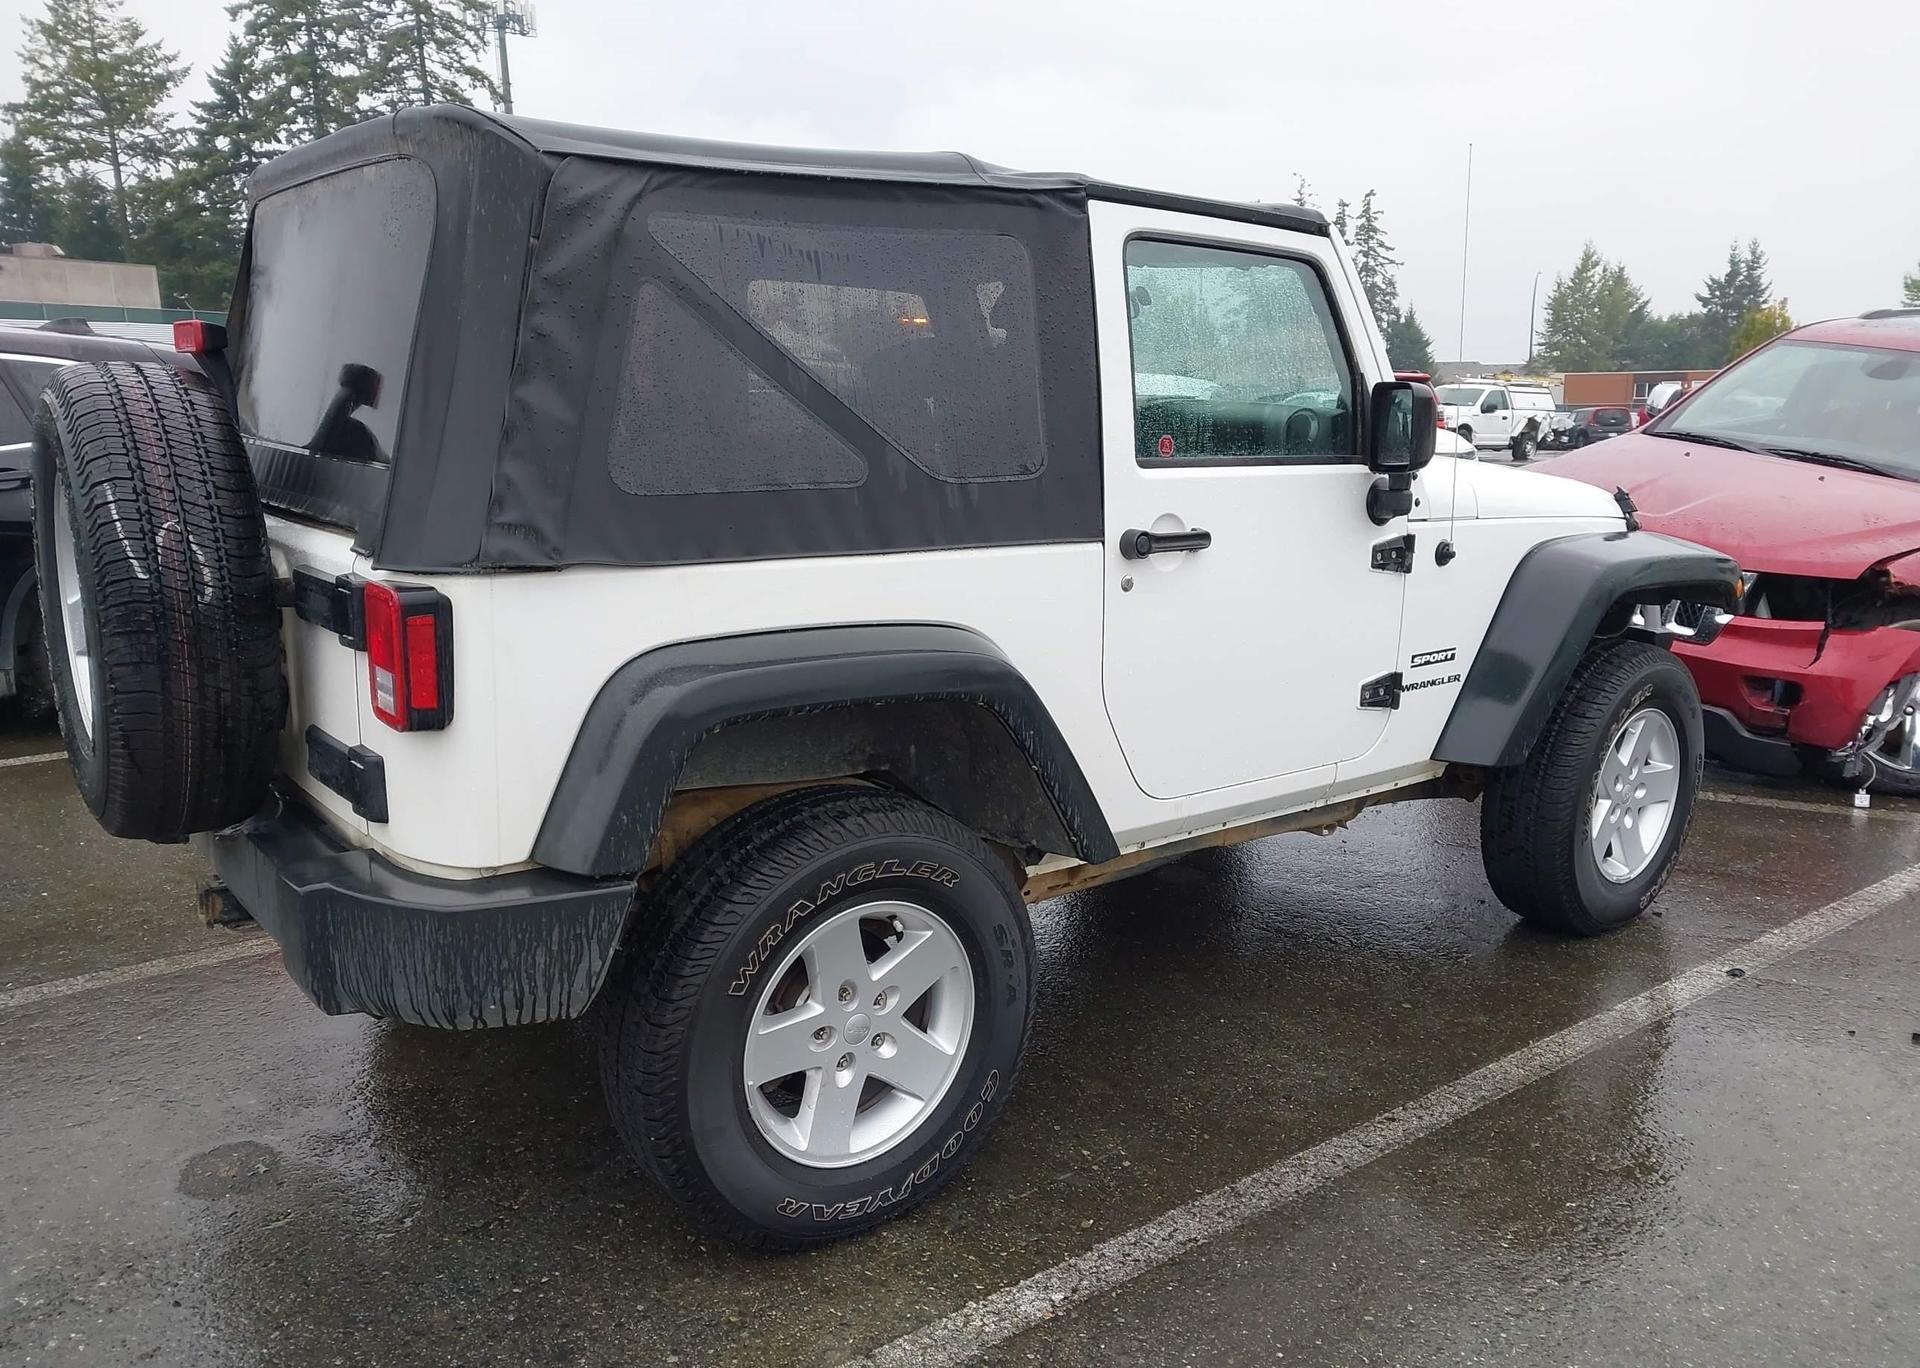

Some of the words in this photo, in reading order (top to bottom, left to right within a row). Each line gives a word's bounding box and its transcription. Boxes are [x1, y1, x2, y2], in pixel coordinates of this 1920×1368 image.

[1401, 673, 1461, 693] WRANGLER
[1411, 649, 1455, 666] SPORT
[728, 859, 961, 996] WRANGLER
[776, 1069, 1000, 1222] GOODYEAR
